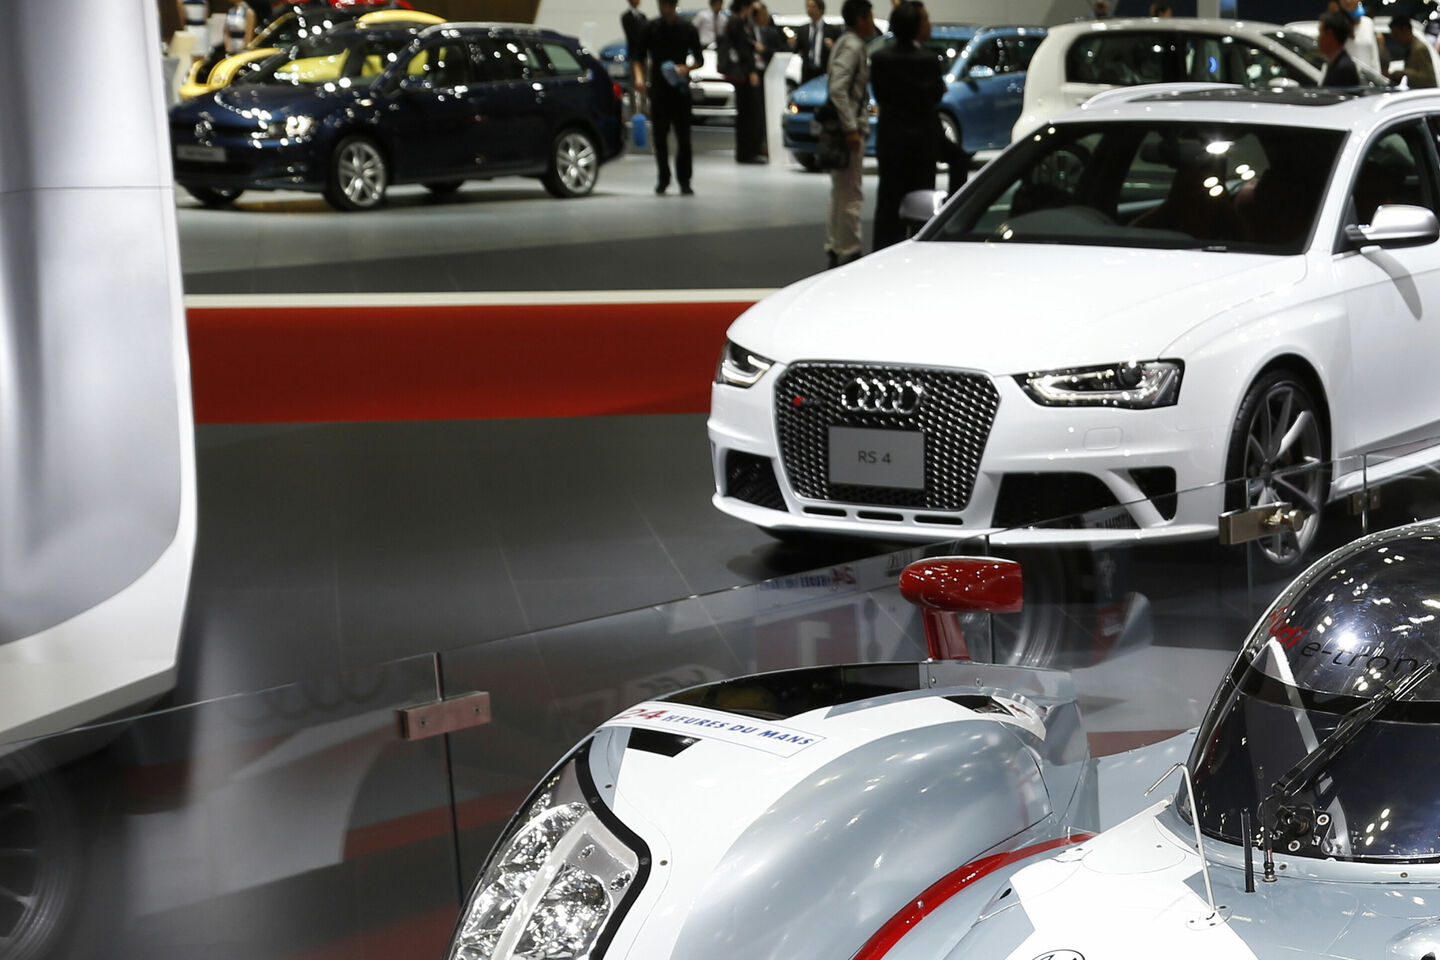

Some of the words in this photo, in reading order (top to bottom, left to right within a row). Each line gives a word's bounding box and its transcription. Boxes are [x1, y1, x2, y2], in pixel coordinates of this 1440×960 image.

[857, 451, 877, 464] RS
[882, 452, 892, 464] 4
[1268, 605, 1309, 649] Audi
[612, 708, 667, 721] 24
[661, 714, 730, 730] HEURES
[728, 723, 759, 735] DU
[757, 729, 815, 746] MANS
